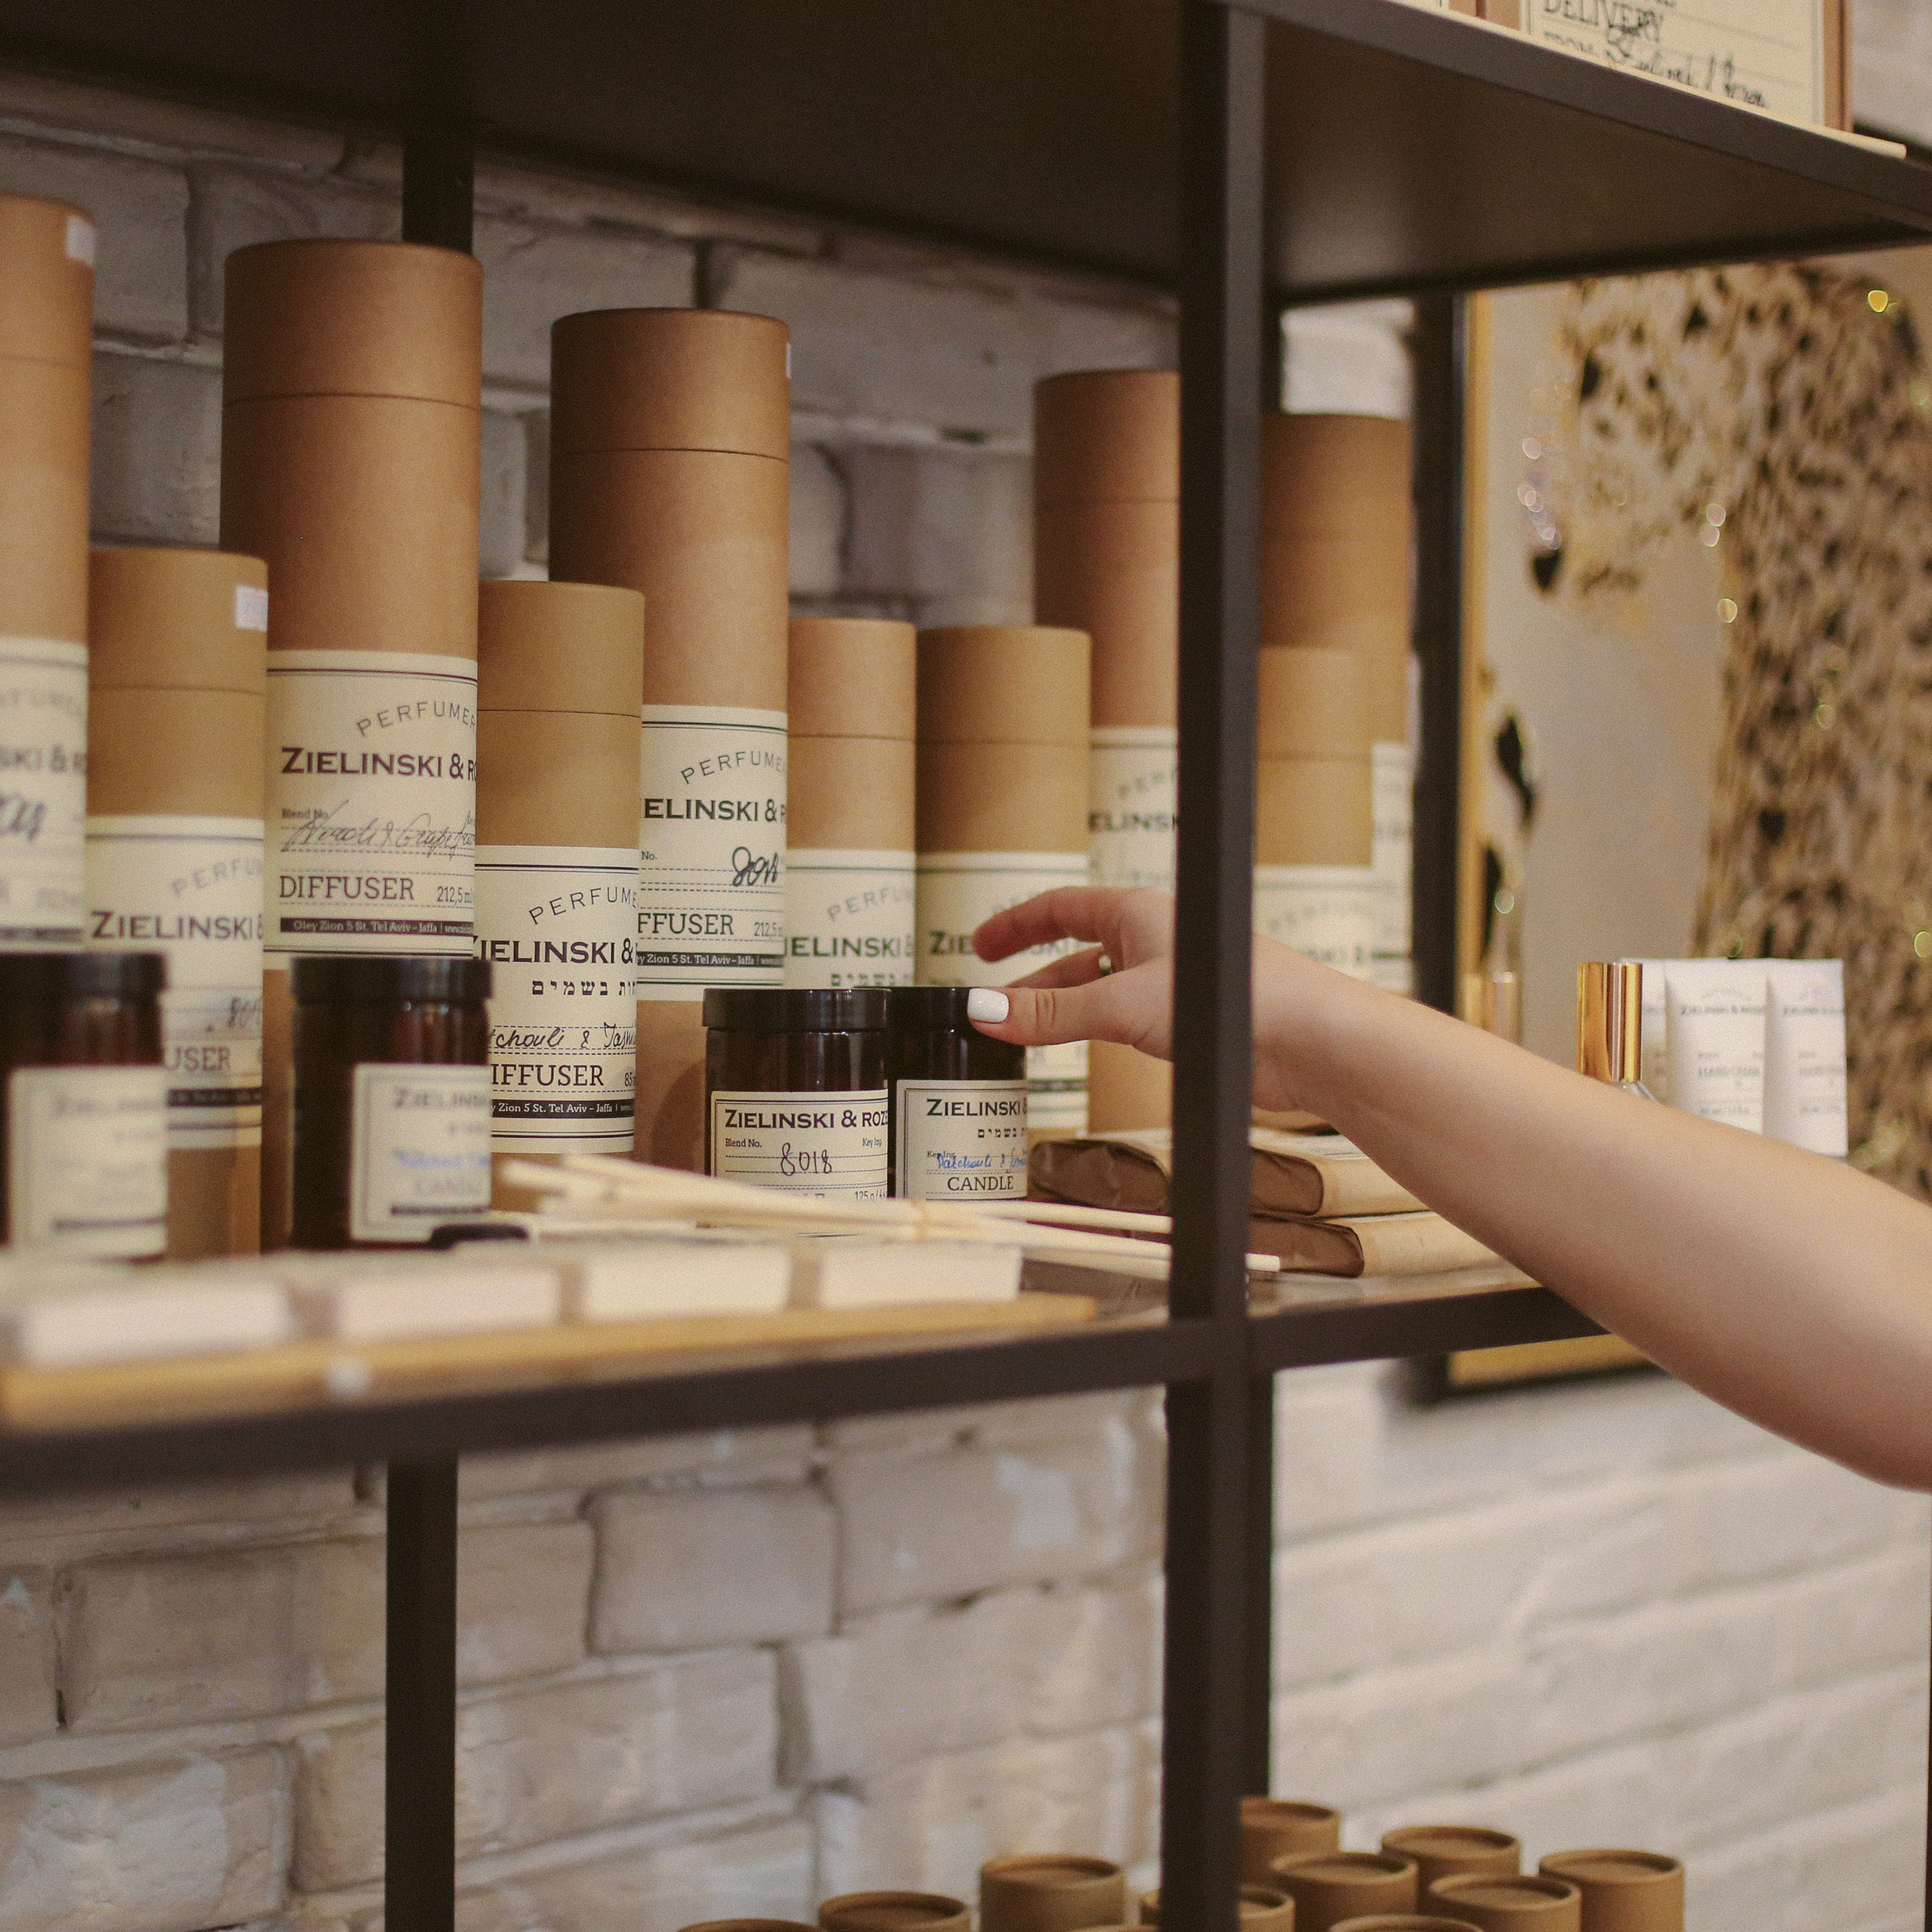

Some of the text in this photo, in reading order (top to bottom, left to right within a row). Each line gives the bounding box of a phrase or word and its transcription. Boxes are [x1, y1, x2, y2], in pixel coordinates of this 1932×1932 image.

[281, 746, 442, 778] ZIELINSKI
[448, 752, 464, 780] &
[764, 798, 778, 823] &
[641, 851, 657, 860] No.
[280, 875, 415, 900] DIFFUSER
[91, 910, 253, 940] ZIELINSKI
[389, 922, 411, 934] Aviv
[621, 938, 633, 964] &
[647, 954, 669, 964] Zion
[672, 955, 678, 964] 5
[694, 955, 710, 964] Tel
[711, 955, 732, 965] Aviv
[738, 955, 754, 965] Jaffa
[531, 980, 609, 996] בשמים
[498, 1103, 521, 1112] Zion
[524, 1103, 531, 1112] 5
[533, 1103, 546, 1113] St.
[548, 1103, 565, 1113] Tel
[566, 1103, 588, 1113] Aviv
[595, 1103, 613, 1113] Jaffa
[926, 1098, 1020, 1116] ZIELINSKI
[724, 1109, 835, 1128] ZIELINSKI
[841, 1109, 857, 1128] &
[725, 1137, 746, 1148] Blend
[748, 1138, 762, 1148] No.
[863, 1137, 873, 1148] Key
[780, 1143, 832, 1177] 8018
[947, 1176, 1014, 1192] CANDLE
